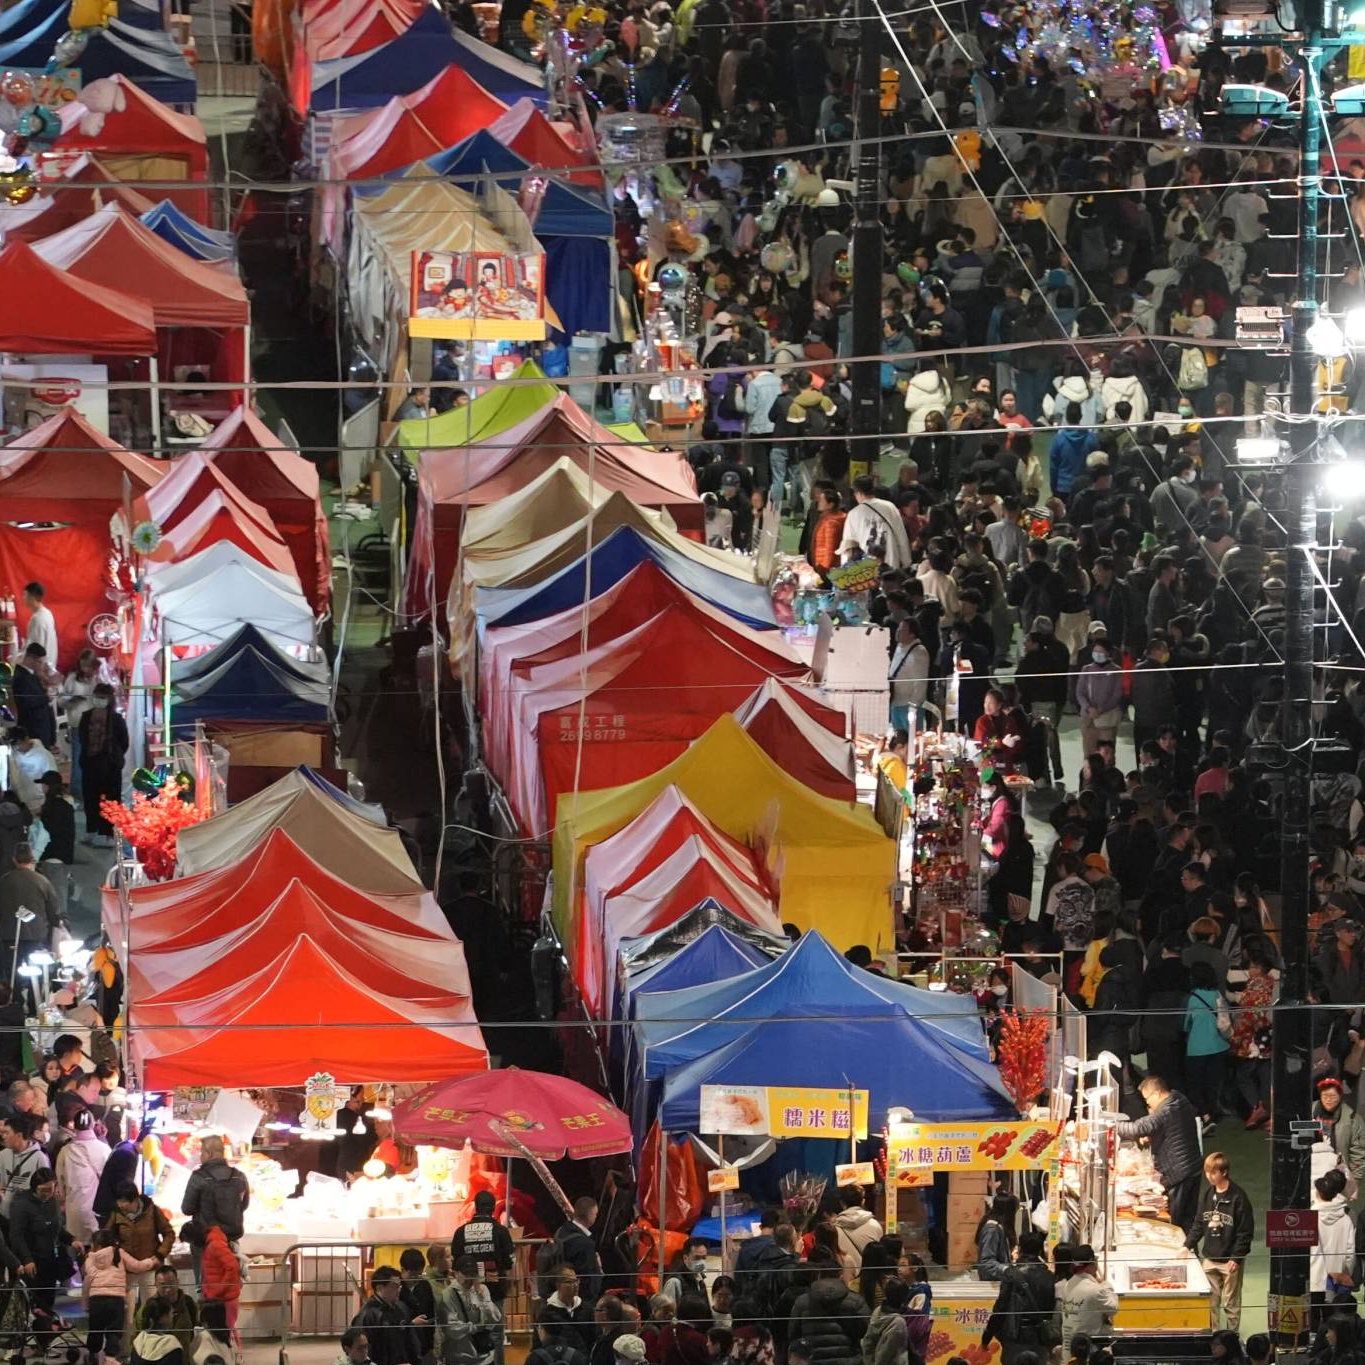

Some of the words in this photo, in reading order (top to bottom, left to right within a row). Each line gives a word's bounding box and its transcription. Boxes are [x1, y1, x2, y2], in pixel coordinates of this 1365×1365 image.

[594, 728, 626, 741] 8779
[898, 1146, 972, 1164] 冰糖葫蘆
